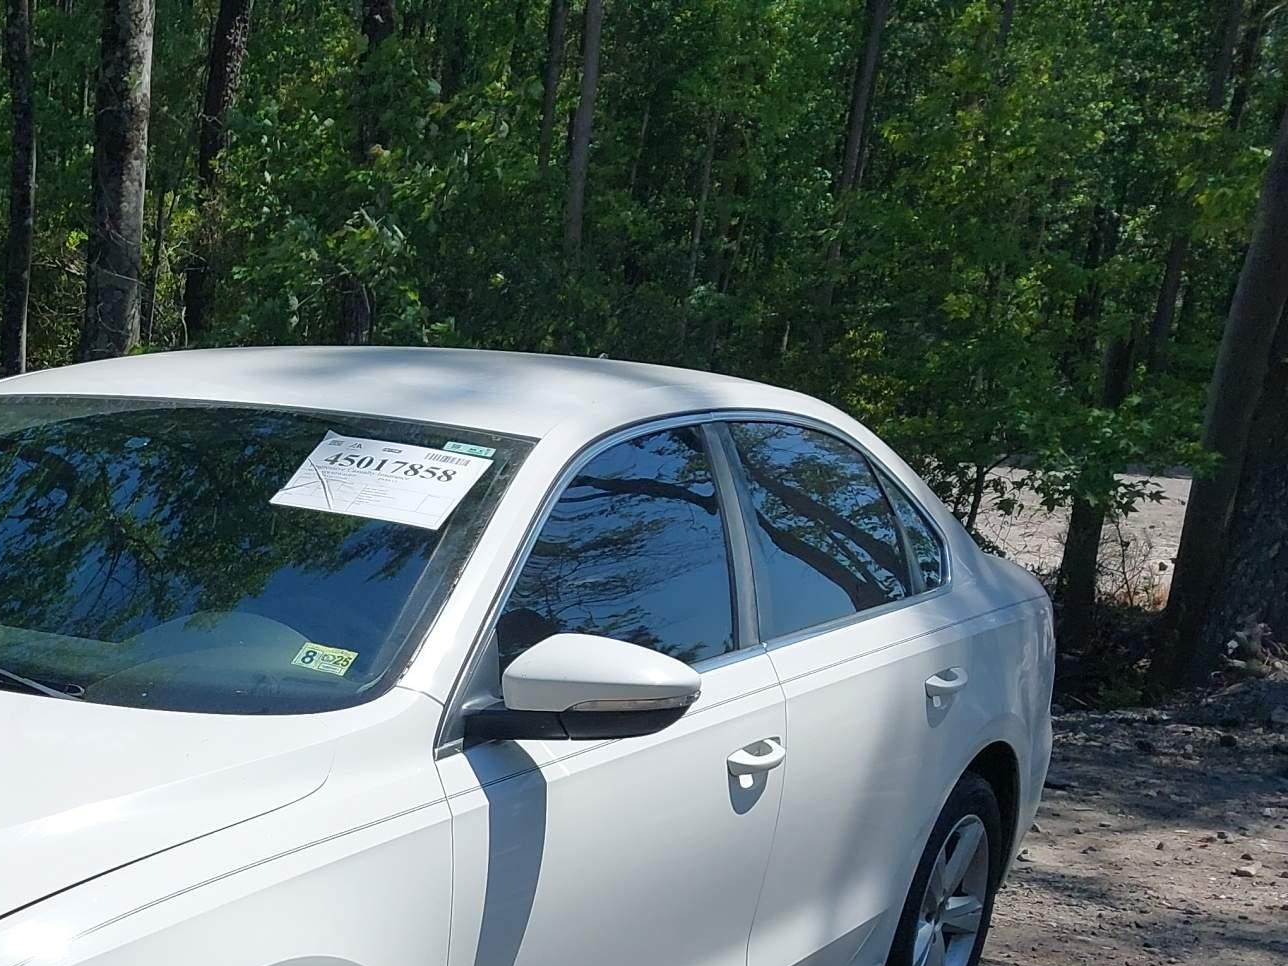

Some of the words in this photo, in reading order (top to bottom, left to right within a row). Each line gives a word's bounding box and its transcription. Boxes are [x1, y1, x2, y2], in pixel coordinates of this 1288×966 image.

[324, 451, 456, 483] 45017858
[301, 649, 317, 665] 8
[334, 655, 352, 668] 25
